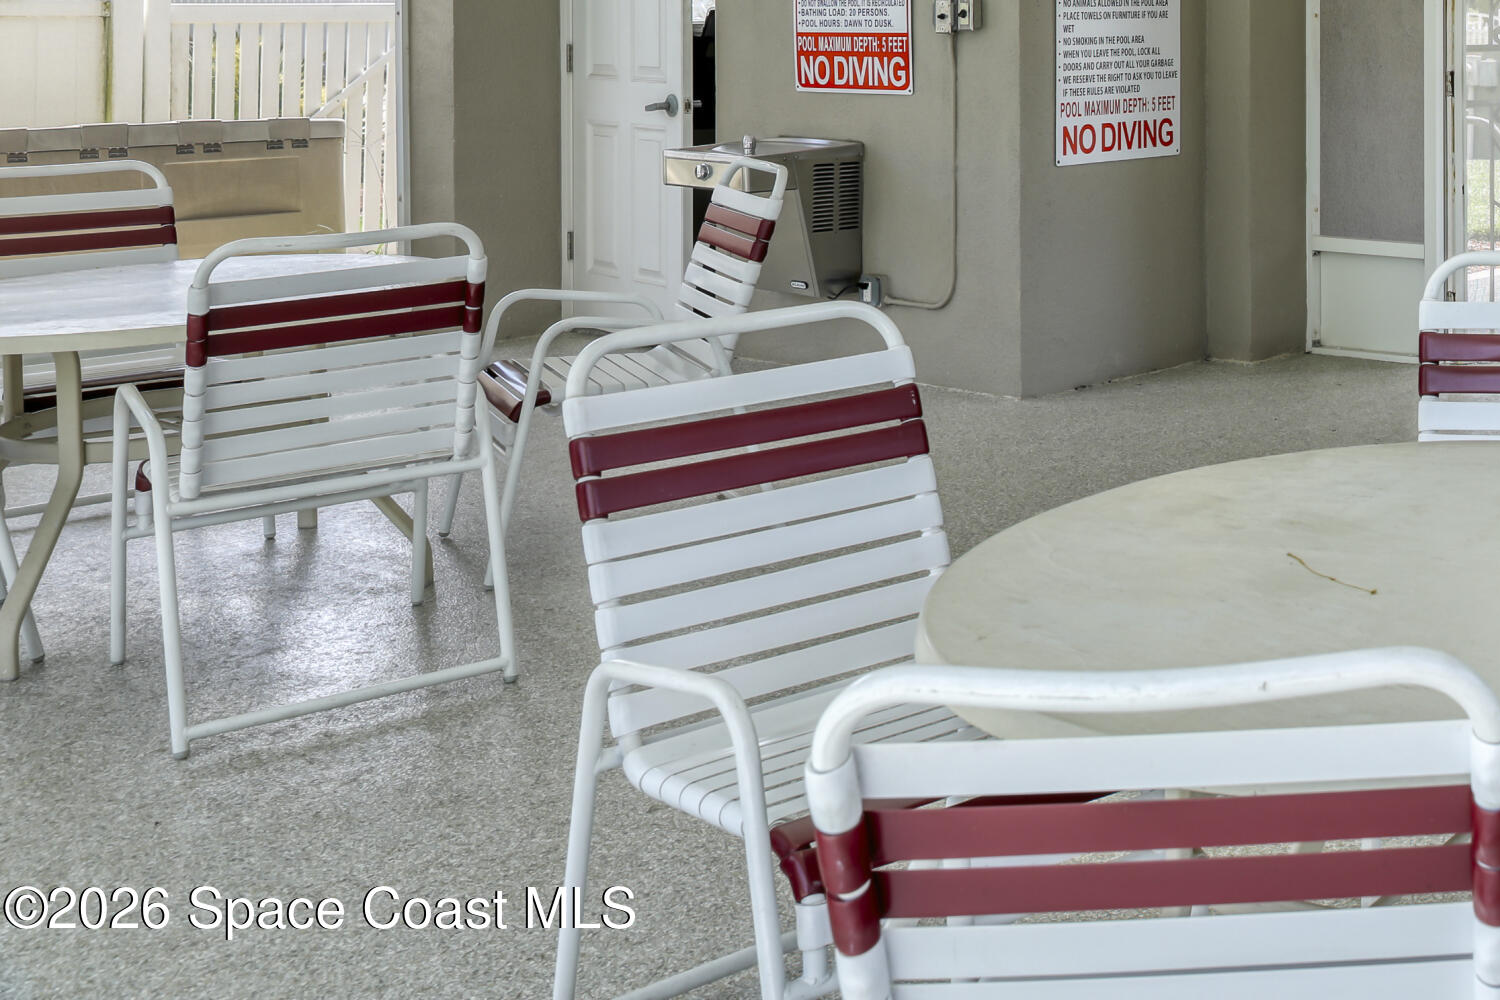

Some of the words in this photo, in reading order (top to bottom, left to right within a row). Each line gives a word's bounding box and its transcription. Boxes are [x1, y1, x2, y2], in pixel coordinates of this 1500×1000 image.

[1063, 25, 1074, 33] WET
[798, 36, 816, 51] POOL
[818, 37, 851, 51] MAXIMUM
[854, 37, 880, 52] DEPTH:
[882, 37, 886, 52] 5
[888, 37, 907, 52] FEET
[800, 55, 830, 85] NO
[834, 56, 906, 87] DIVING
[1060, 102, 1082, 118] POOL
[1084, 100, 1120, 116] MAXIMUM
[1123, 98, 1149, 114] DEPTH:
[1152, 97, 1155, 111] 5
[1158, 96, 1175, 111] FEET
[1063, 124, 1096, 156] NO
[1102, 118, 1173, 152] DIVING
